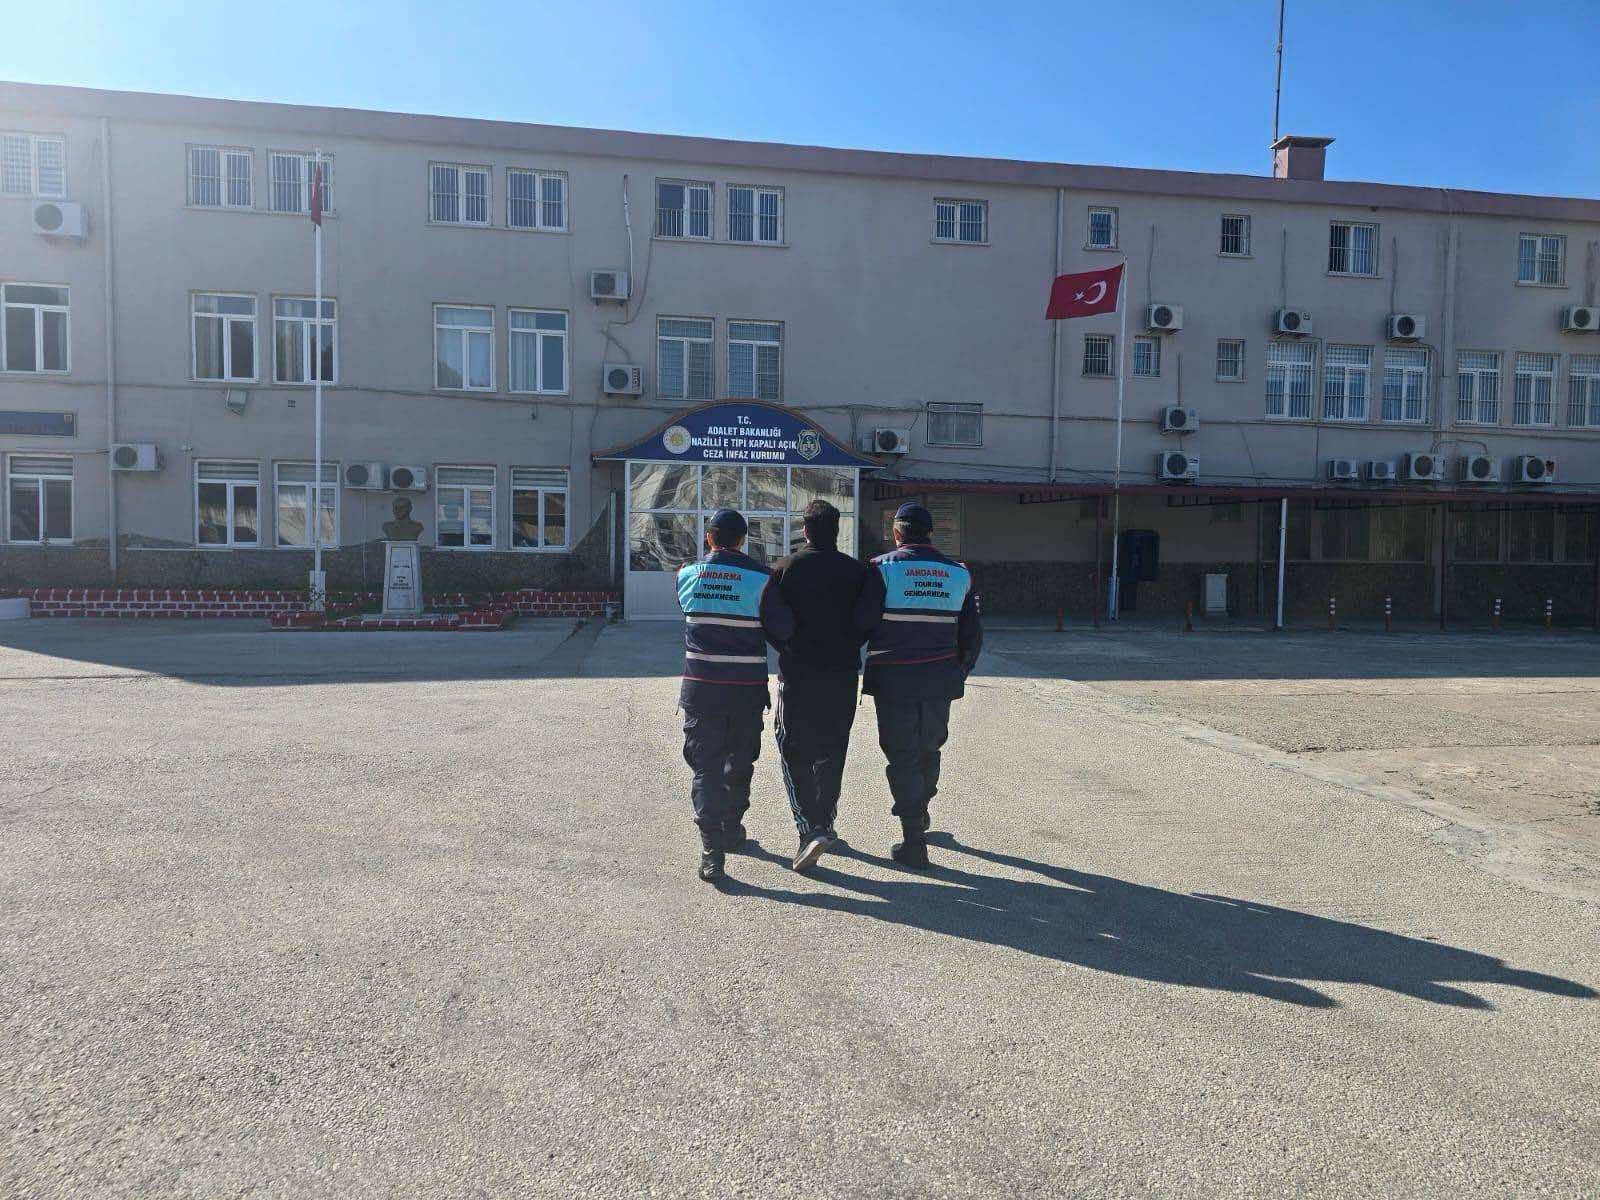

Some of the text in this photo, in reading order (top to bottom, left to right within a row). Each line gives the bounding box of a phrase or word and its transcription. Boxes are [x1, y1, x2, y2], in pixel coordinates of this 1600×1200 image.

[737, 416, 752, 425] T.C.
[708, 426, 781, 437] ADALET BAKANLIĞI
[691, 437, 722, 447] NAZİLLİ
[723, 438, 729, 447] E
[748, 439, 777, 449] KAPALI
[778, 440, 797, 450] AÇIK
[703, 449, 724, 458] CEZA
[750, 450, 785, 460] KURUMU
[697, 571, 742, 581] JANDARMA
[904, 568, 950, 577] JANDARMA
[702, 583, 733, 591] TOURISM
[693, 592, 741, 601] GENDARMERIE
[904, 590, 951, 598] GENDARMERIE
